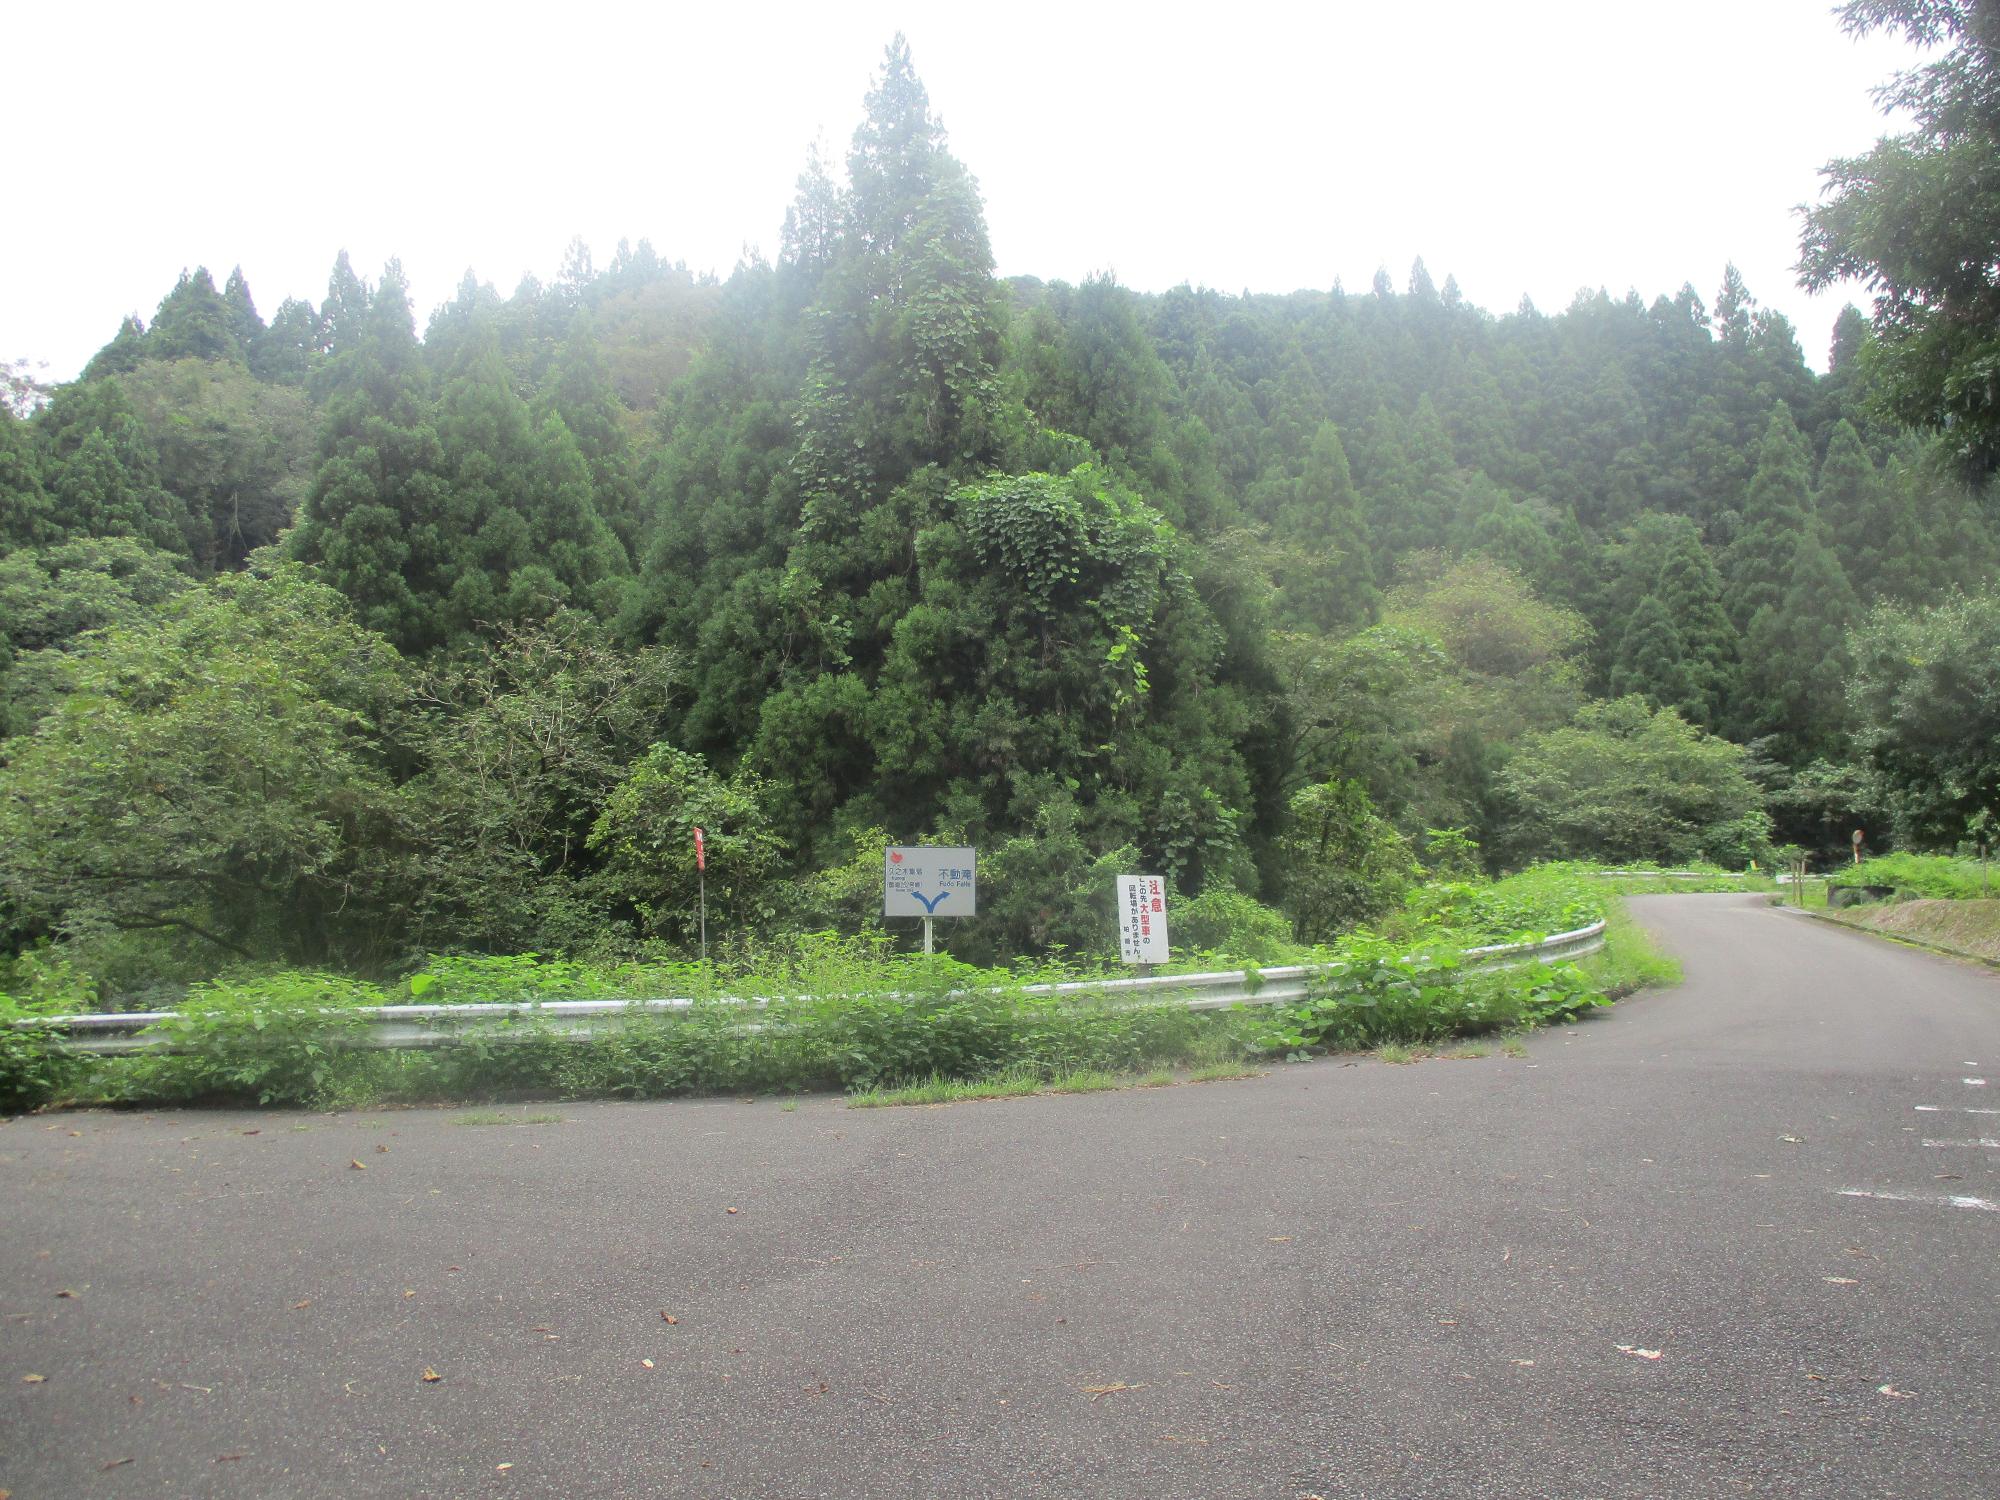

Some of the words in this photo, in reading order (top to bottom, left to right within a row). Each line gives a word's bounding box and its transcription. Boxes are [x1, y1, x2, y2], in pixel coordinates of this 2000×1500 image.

[1139, 878, 1150, 944] この先大型車の
[1149, 880, 1162, 912] 注意
